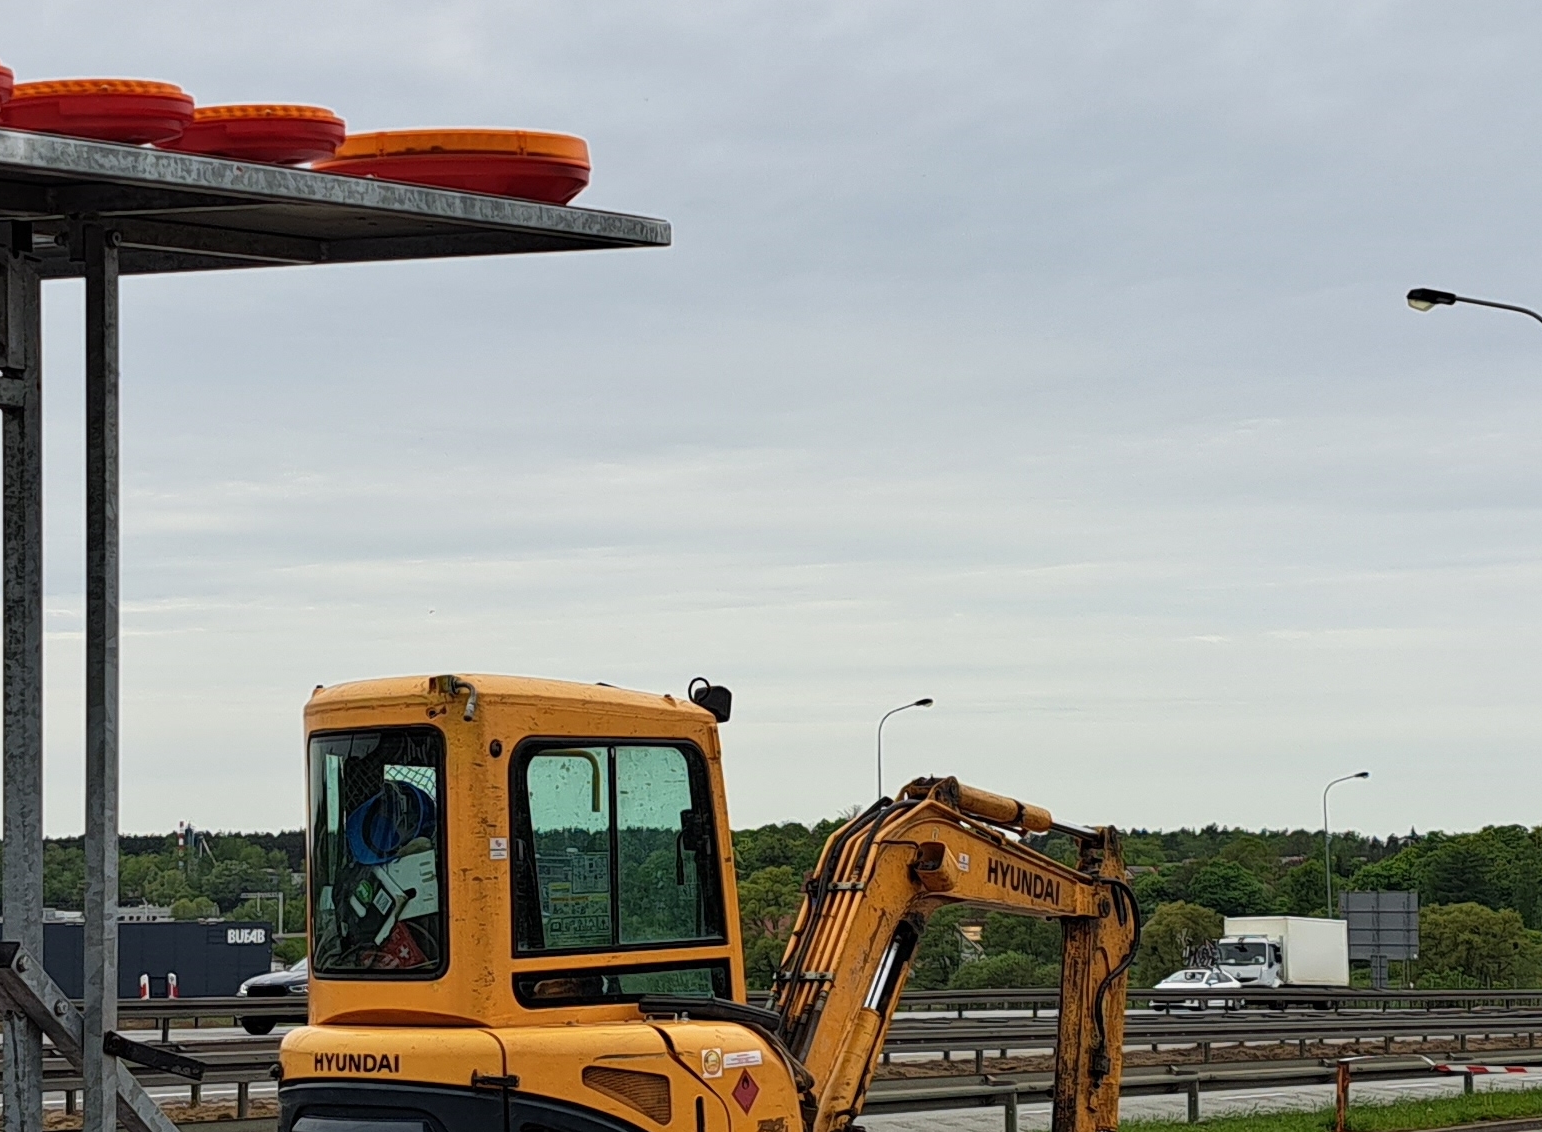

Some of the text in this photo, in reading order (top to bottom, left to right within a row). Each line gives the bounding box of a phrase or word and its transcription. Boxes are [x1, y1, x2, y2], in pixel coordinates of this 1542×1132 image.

[987, 857, 1061, 906] HYUNDAI
[227, 928, 266, 944] BUFAB
[314, 1052, 400, 1074] HYUNDAI
